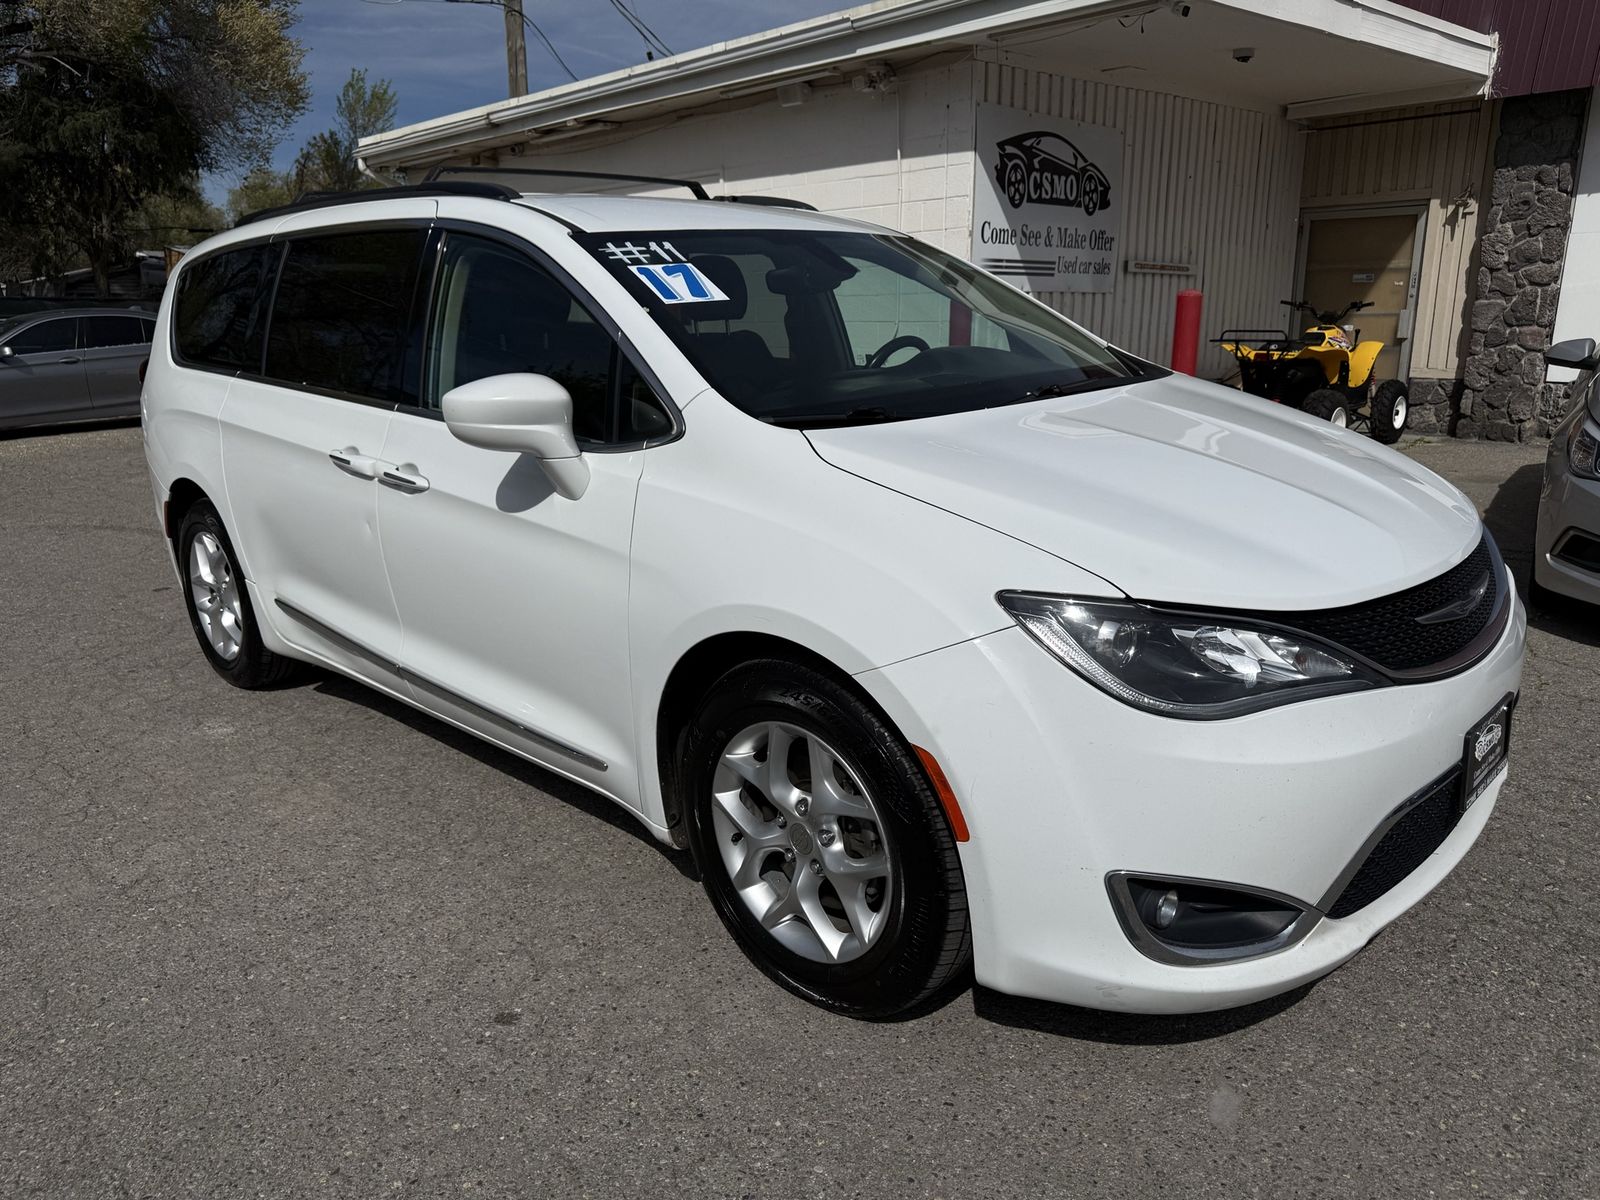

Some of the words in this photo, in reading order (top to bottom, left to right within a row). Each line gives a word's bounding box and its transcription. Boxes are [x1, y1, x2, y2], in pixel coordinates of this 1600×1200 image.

[1029, 171, 1077, 200] CSMO
[981, 221, 1017, 246] Come
[1020, 224, 1041, 247] See
[1044, 226, 1054, 247] &
[1056, 227, 1086, 250] Make
[1089, 229, 1115, 251] Offer
[598, 241, 688, 264] #11
[1057, 256, 1077, 274] Used
[1079, 262, 1092, 274] car
[1093, 259, 1111, 276] sales
[636, 264, 713, 301] 17
